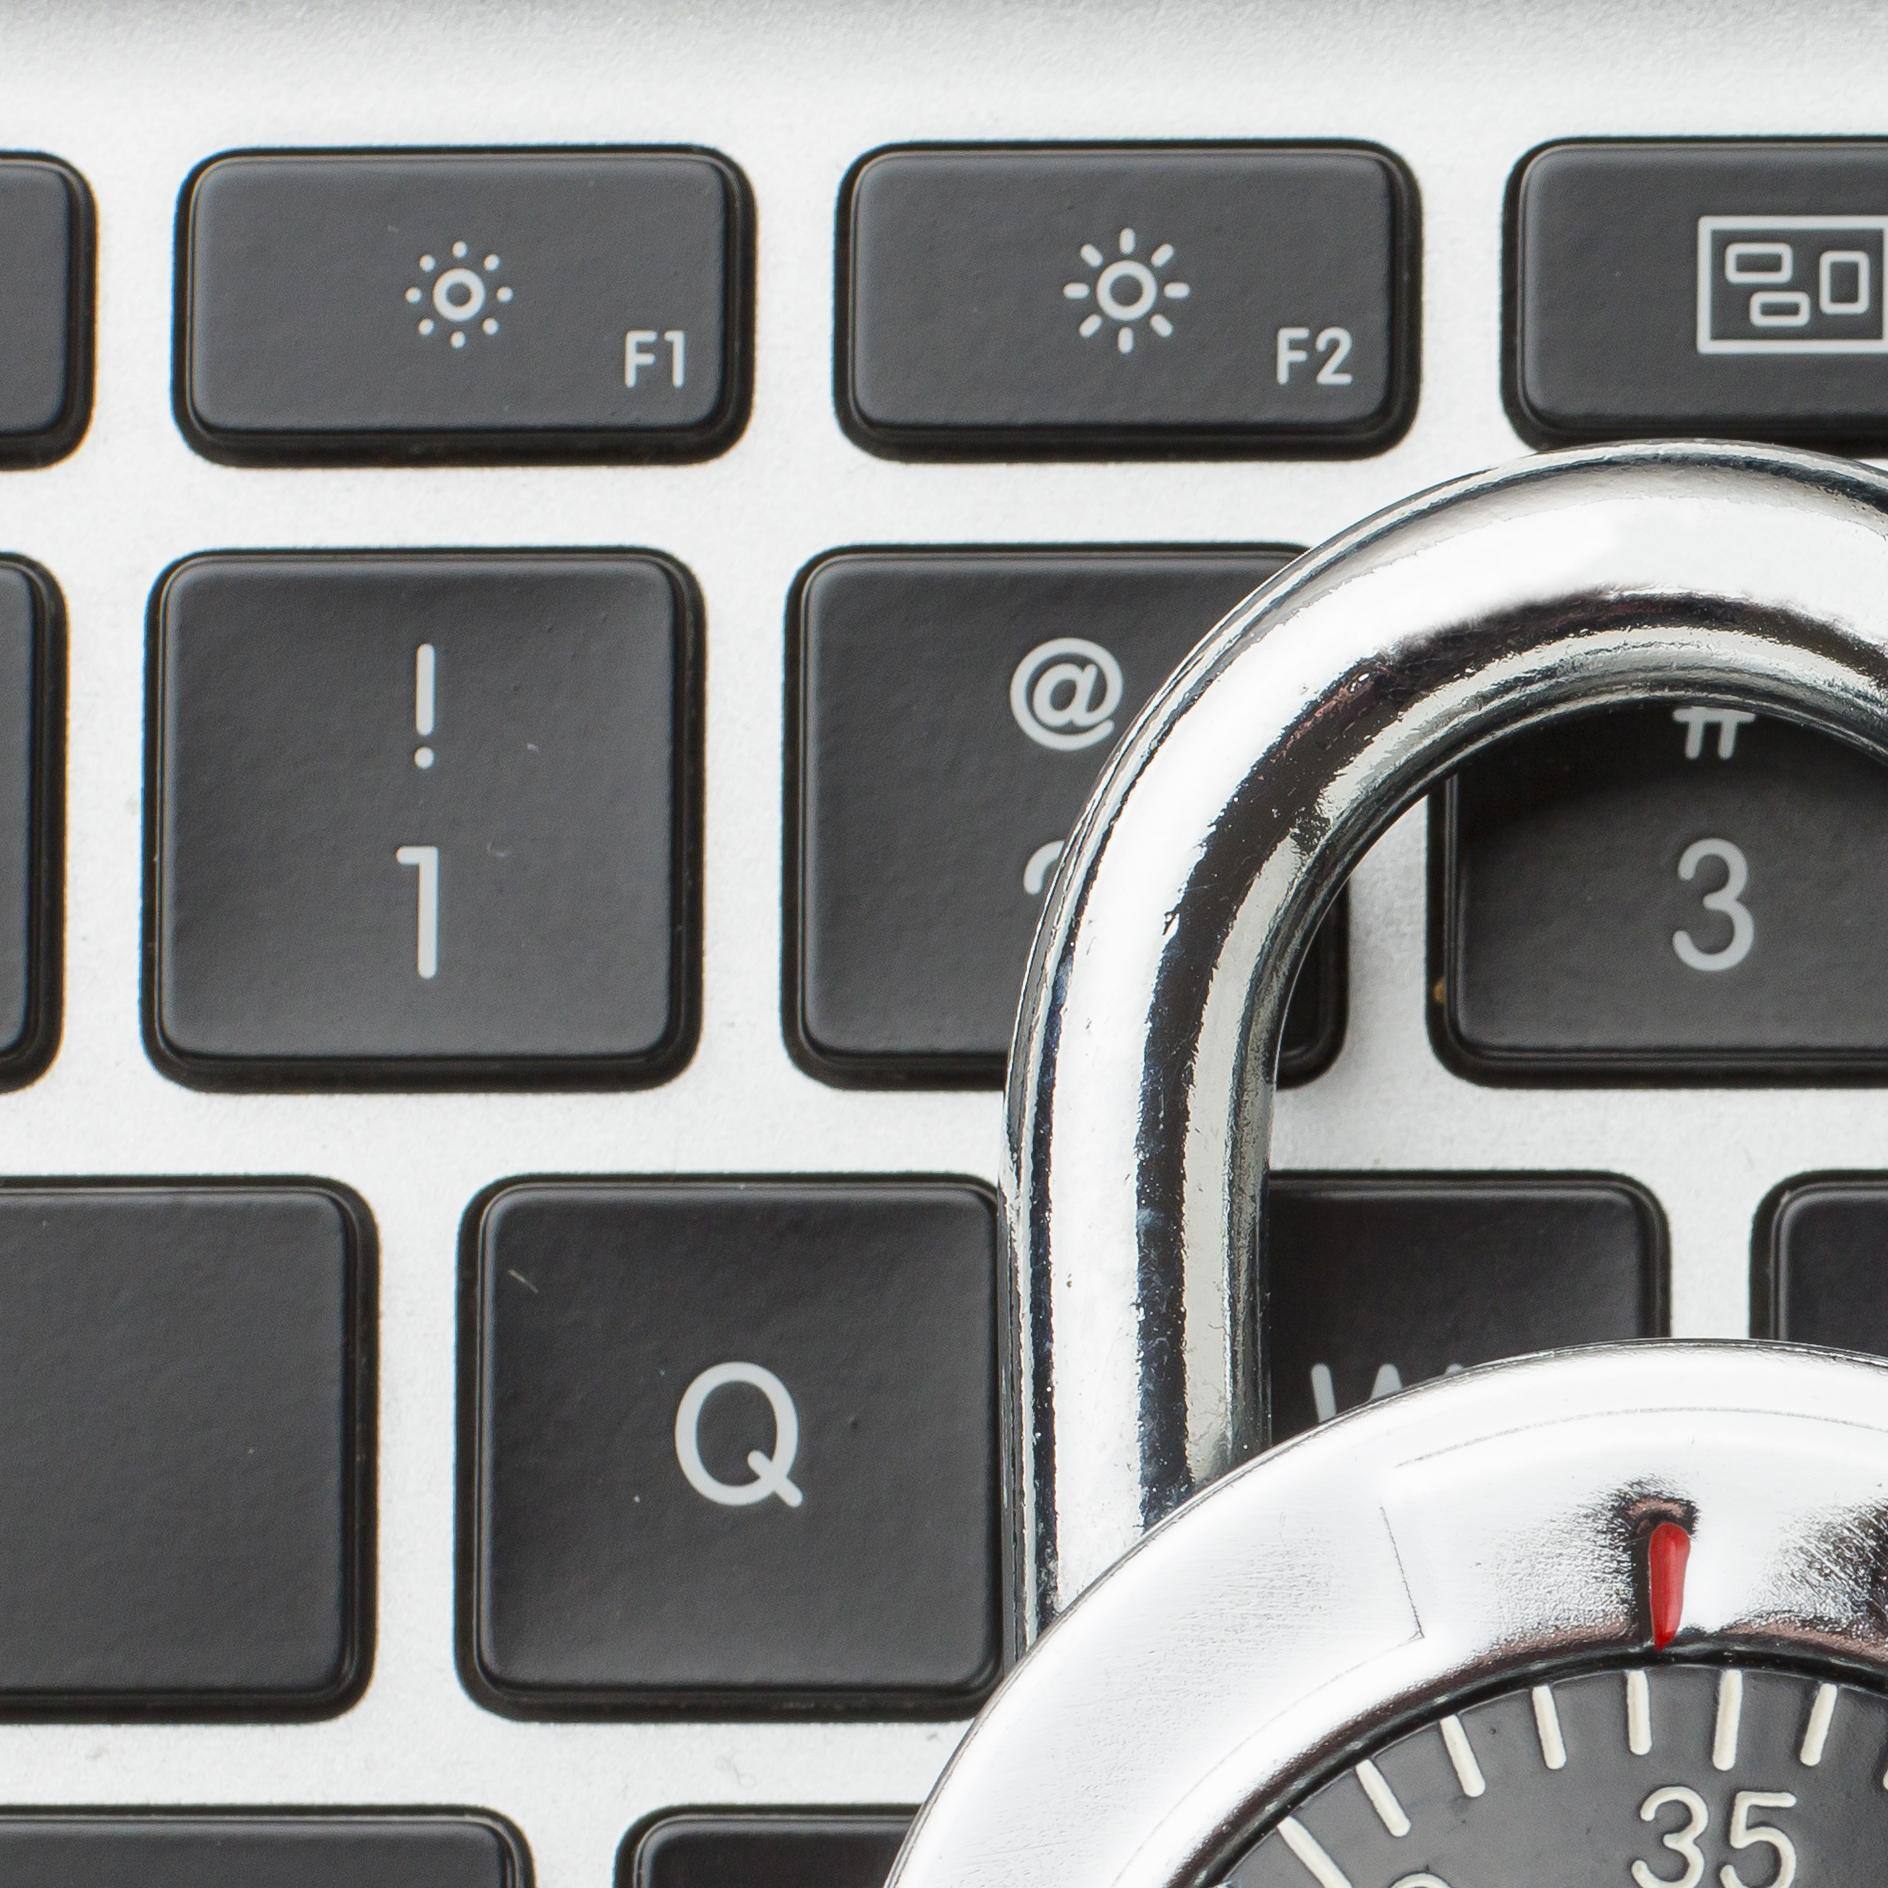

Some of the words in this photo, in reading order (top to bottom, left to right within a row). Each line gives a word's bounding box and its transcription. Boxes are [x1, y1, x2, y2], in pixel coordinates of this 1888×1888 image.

[624, 330, 686, 389] F1
[1276, 326, 1353, 386] F2
[414, 643, 436, 770] !
[1009, 637, 1122, 752] @
[395, 846, 439, 980] 1
[1672, 838, 1755, 973] 3
[674, 1361, 804, 1508] Q
